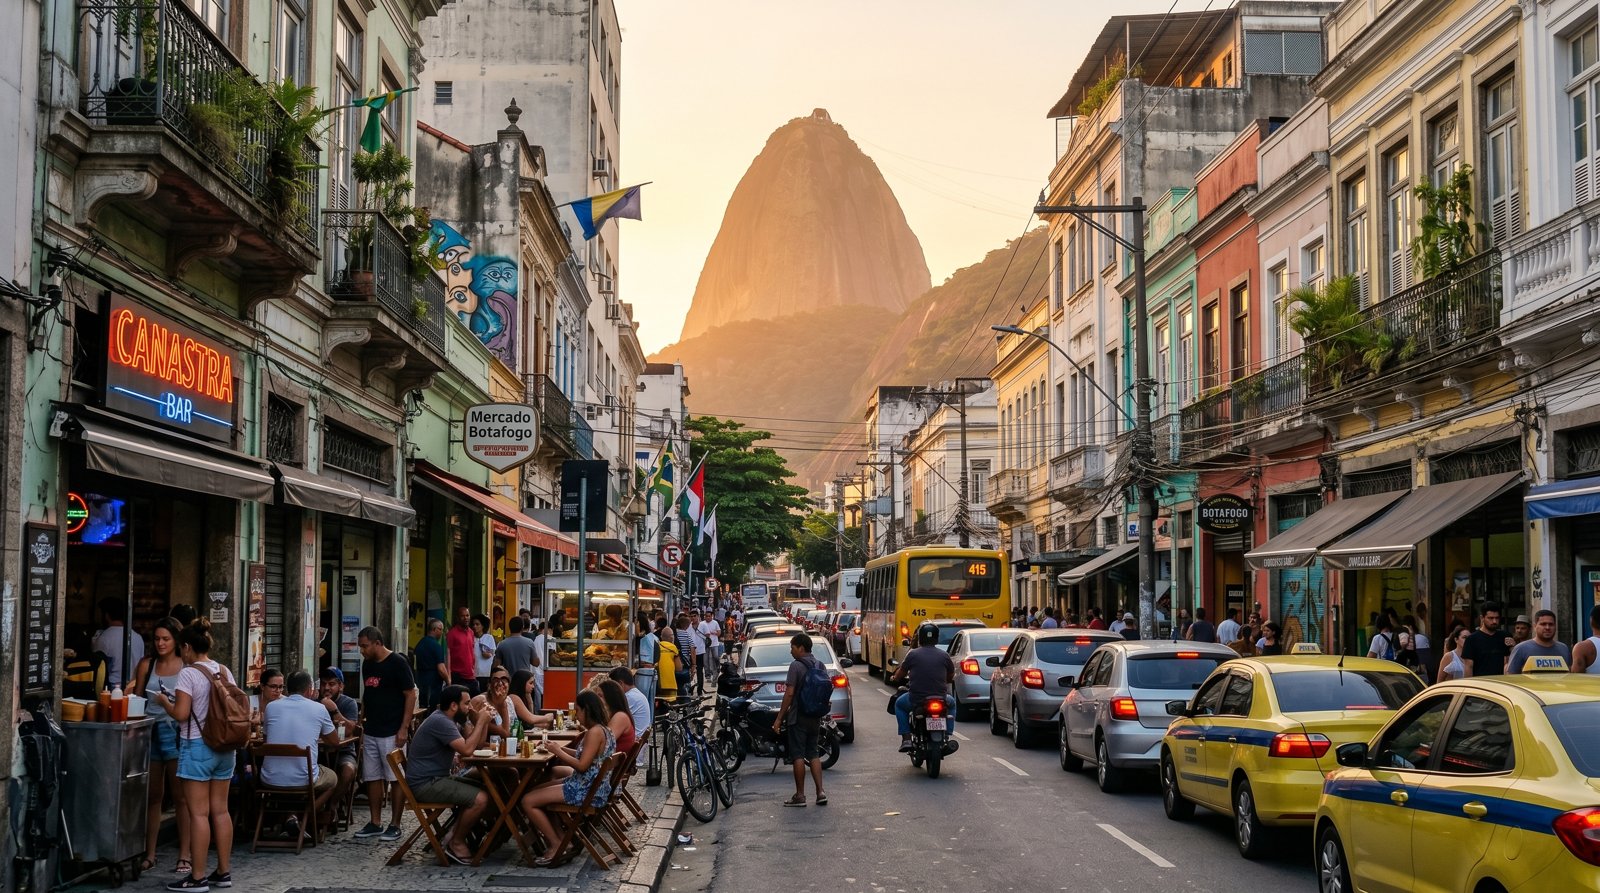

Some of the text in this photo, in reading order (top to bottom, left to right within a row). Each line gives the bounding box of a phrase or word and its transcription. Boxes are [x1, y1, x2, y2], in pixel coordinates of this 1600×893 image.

[116, 309, 233, 403] CANASTRA
[166, 392, 192, 424] BAR
[471, 411, 531, 423] Mercado
[469, 425, 532, 441] Botafogo
[1202, 508, 1248, 518] BOTAFOGO
[668, 547, 678, 562] E
[968, 563, 987, 576] 415
[911, 608, 927, 617] 415
